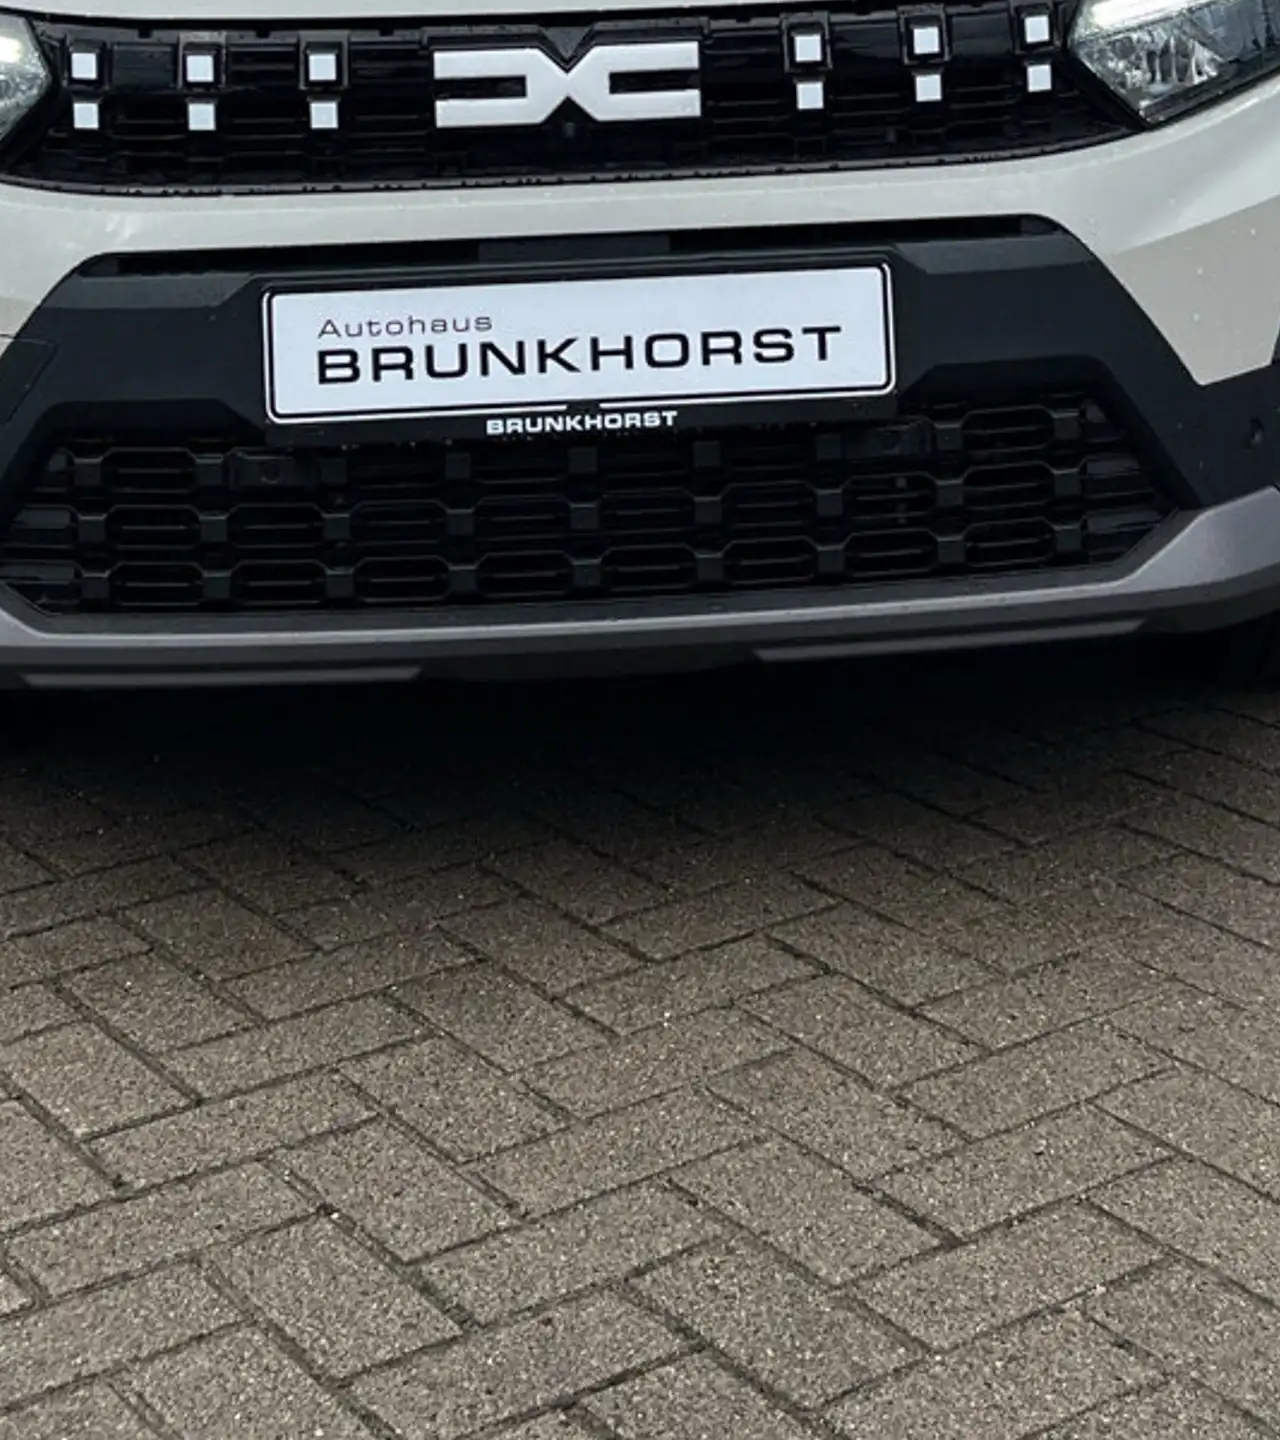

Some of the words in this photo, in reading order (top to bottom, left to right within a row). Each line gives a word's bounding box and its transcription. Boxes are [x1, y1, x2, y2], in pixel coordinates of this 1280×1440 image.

[317, 316, 493, 339] Autohaus
[317, 325, 842, 385] BRUNKHORST
[486, 410, 678, 435] BRUNKHORST
